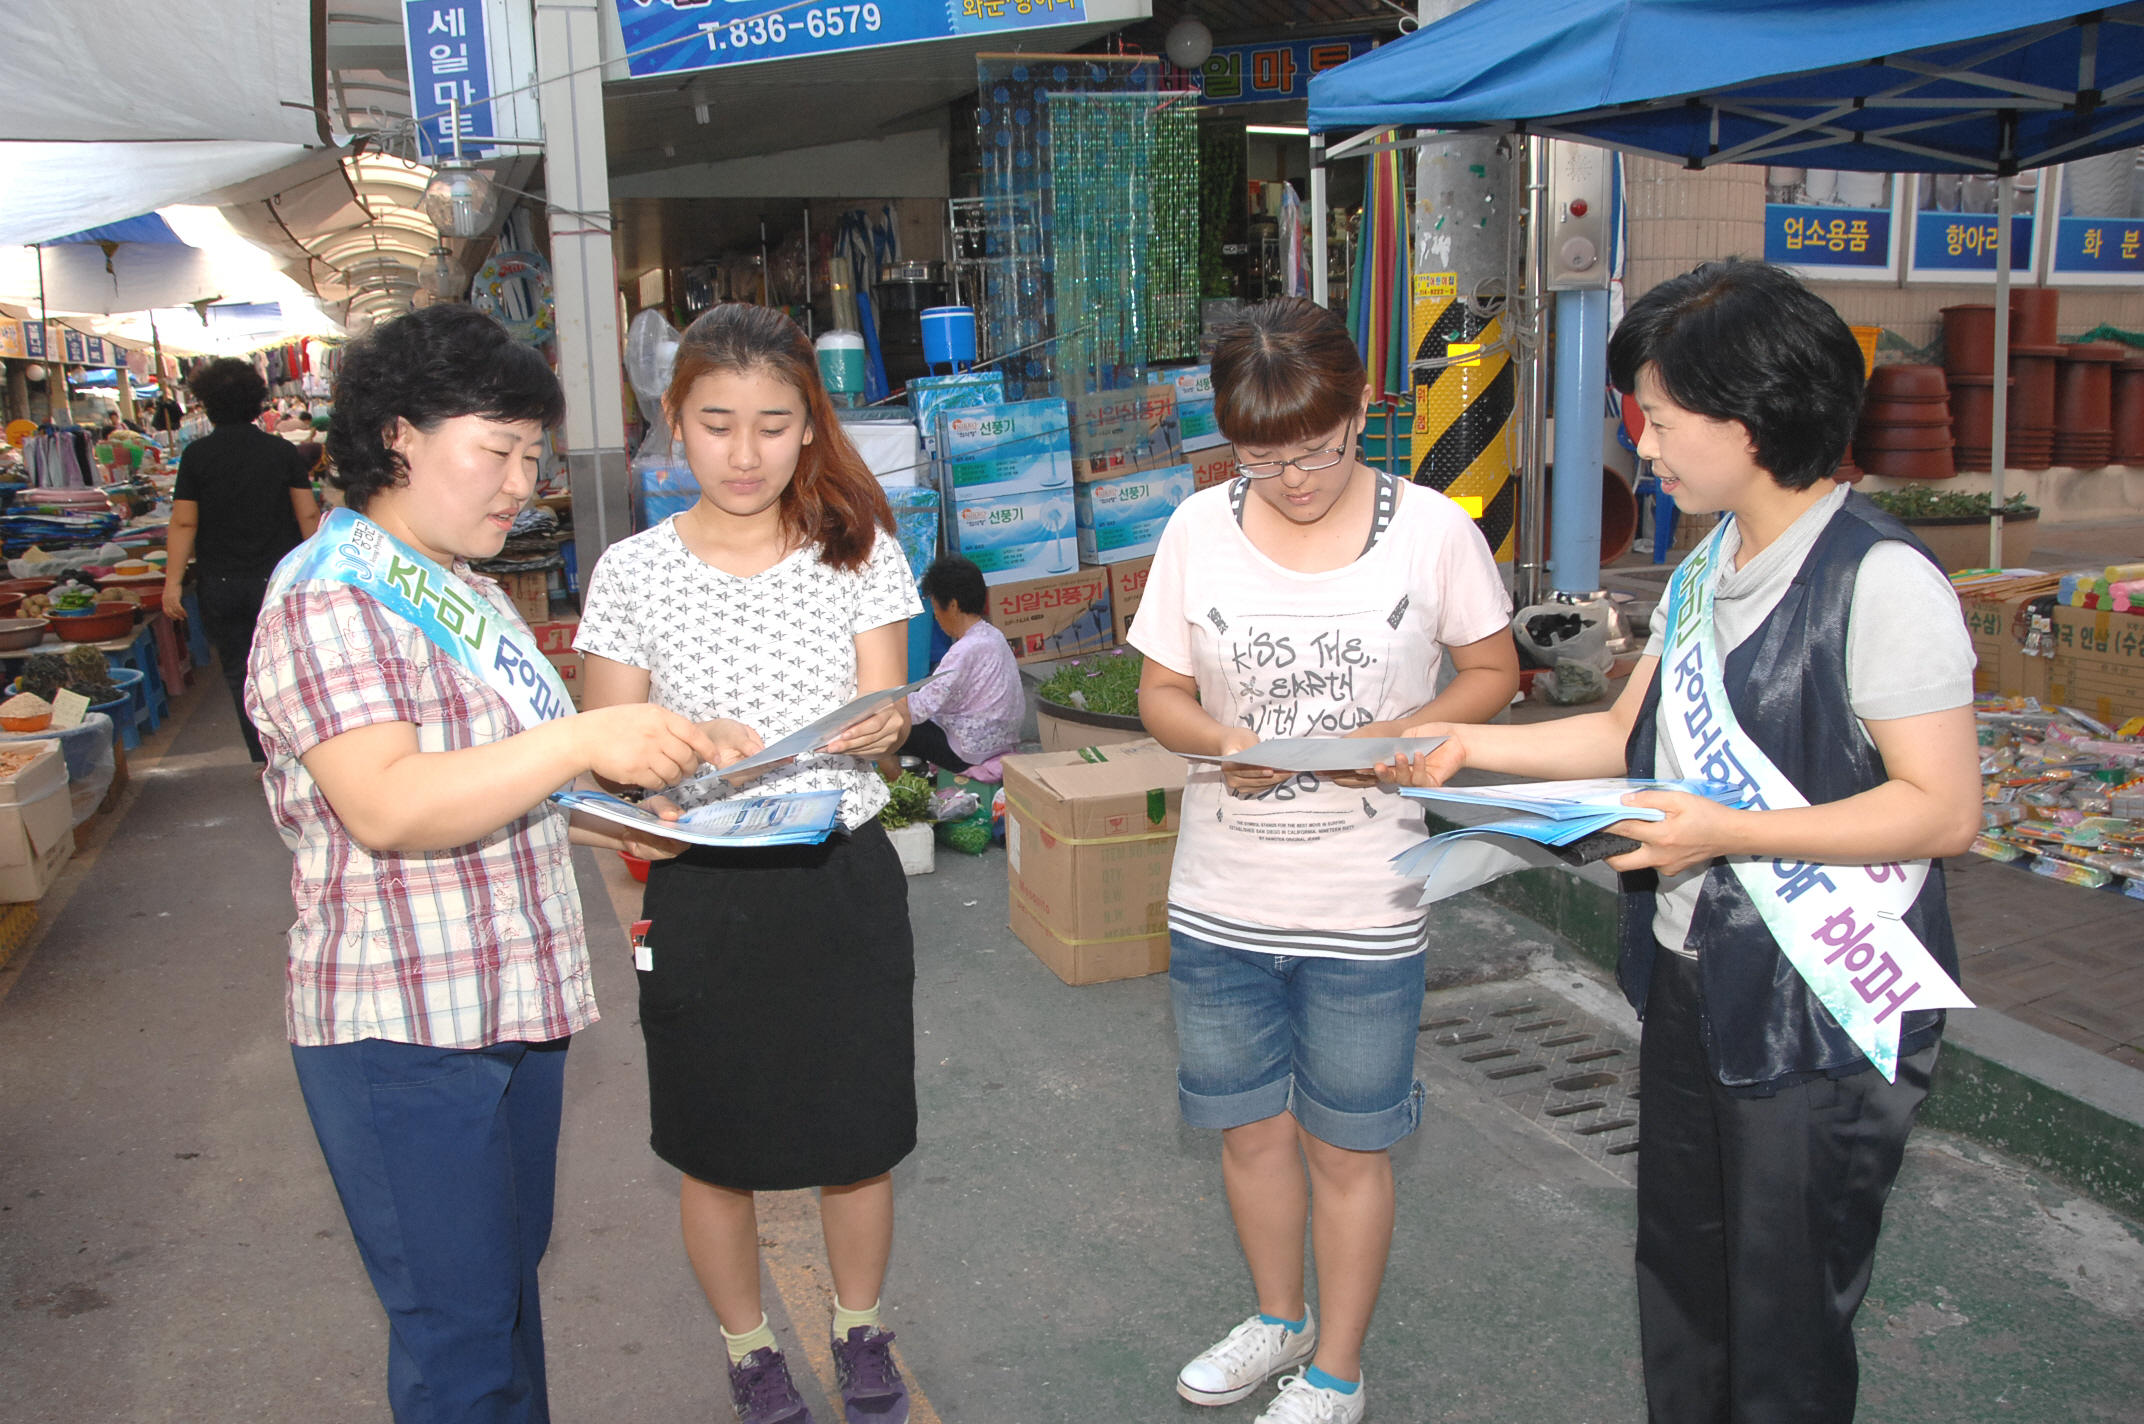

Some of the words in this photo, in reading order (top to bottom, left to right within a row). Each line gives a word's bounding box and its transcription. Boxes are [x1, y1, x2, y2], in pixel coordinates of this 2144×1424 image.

[698, 3, 882, 51] T.836-6579
[428, 7, 476, 145] 세일마트
[1784, 216, 1870, 253] 업소용품
[979, 417, 1016, 437] 선풍기
[1119, 483, 1150, 502] 선풍기
[988, 506, 1025, 525] 선풍기
[387, 556, 487, 651] 주민
[1000, 582, 1103, 615] 신일선풍기
[1677, 546, 1711, 649] 주민
[1811, 906, 1922, 1025] 홍보
